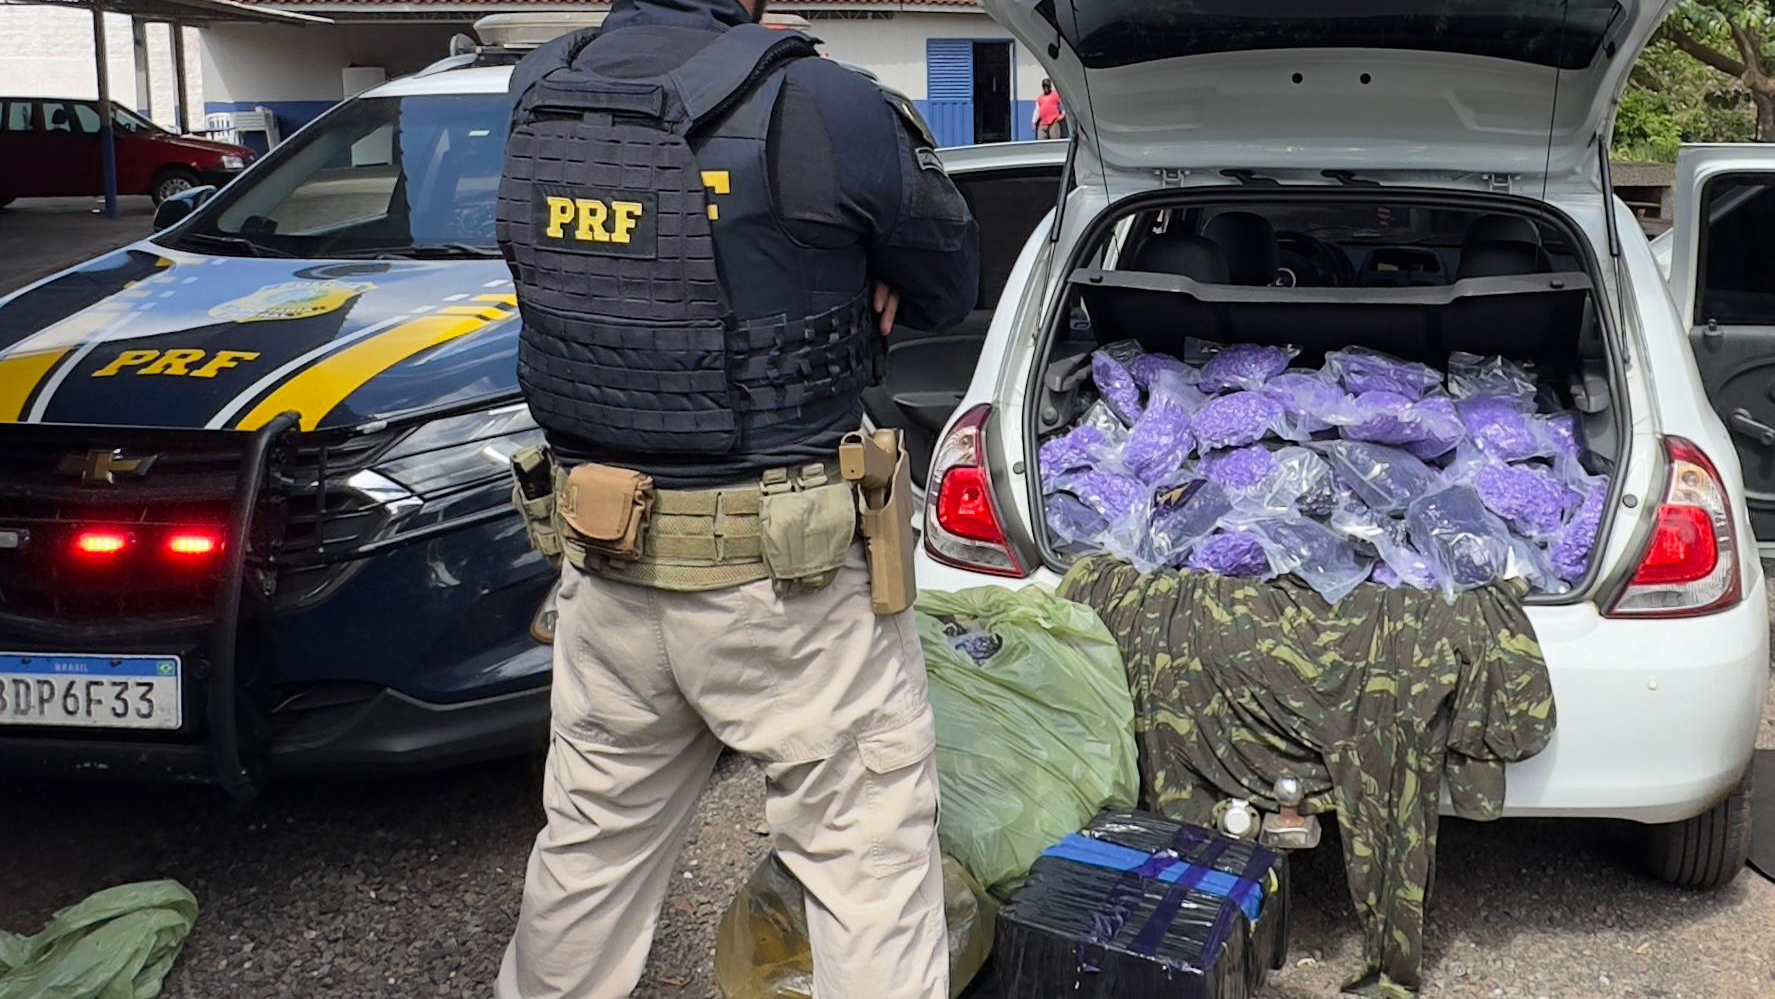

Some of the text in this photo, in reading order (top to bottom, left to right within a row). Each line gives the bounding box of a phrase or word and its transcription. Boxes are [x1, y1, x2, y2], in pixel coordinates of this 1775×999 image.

[546, 196, 643, 244] PRF
[91, 349, 261, 378] PRF
[54, 663, 88, 672] BRASIL
